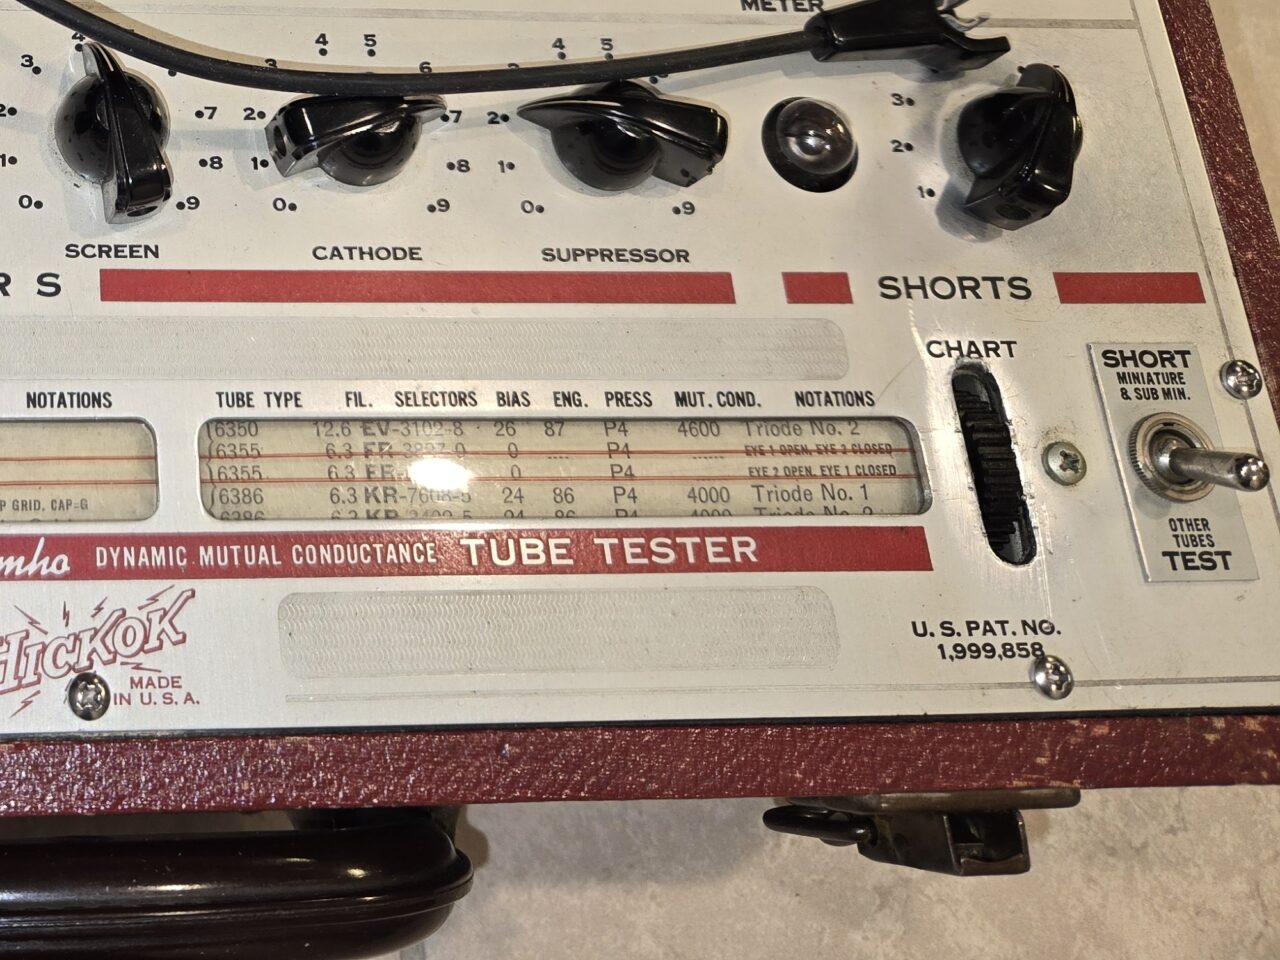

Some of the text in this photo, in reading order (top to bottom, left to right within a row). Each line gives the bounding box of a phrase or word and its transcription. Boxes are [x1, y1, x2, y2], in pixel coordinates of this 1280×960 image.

[64, 244, 159, 259] SCREEN
[312, 246, 423, 261] CATHODE
[541, 248, 690, 263] SUPPRESSOR
[878, 275, 1032, 300] SHORTS
[926, 340, 1018, 358] CHART
[1102, 350, 1192, 368] SHORT
[1117, 372, 1186, 386] MINIATURE
[26, 391, 112, 408] NOTATIONS
[216, 391, 875, 408] TUBE TYPE FIL. SELECTORS BIAS ENG. PRESS MUT. COND. NOTATIONS
[1121, 387, 1191, 401] & SUB MIN.
[219, 487, 264, 505] 6386
[330, 487, 358, 504] 6.3
[502, 487, 524, 504] 24
[553, 487, 575, 504] 86
[613, 486, 638, 504] P4
[687, 486, 731, 503] 4000
[751, 484, 813, 503] Triode
[820, 484, 853, 502] No.
[1169, 517, 1211, 532] OTHER
[1172, 534, 1215, 548] TUBES
[96, 546, 187, 569] DYNAMIC
[198, 544, 282, 567] MUTUAL
[291, 542, 439, 566] CONDUCTANCE
[460, 538, 574, 568] TUBE
[594, 536, 759, 566] TESTER
[1162, 551, 1232, 571] TEST
[911, 620, 1061, 637] U. S. PAT. NO.
[937, 642, 1045, 661] 1,999,858
[131, 676, 183, 691] MADE
[113, 693, 132, 706] IN
